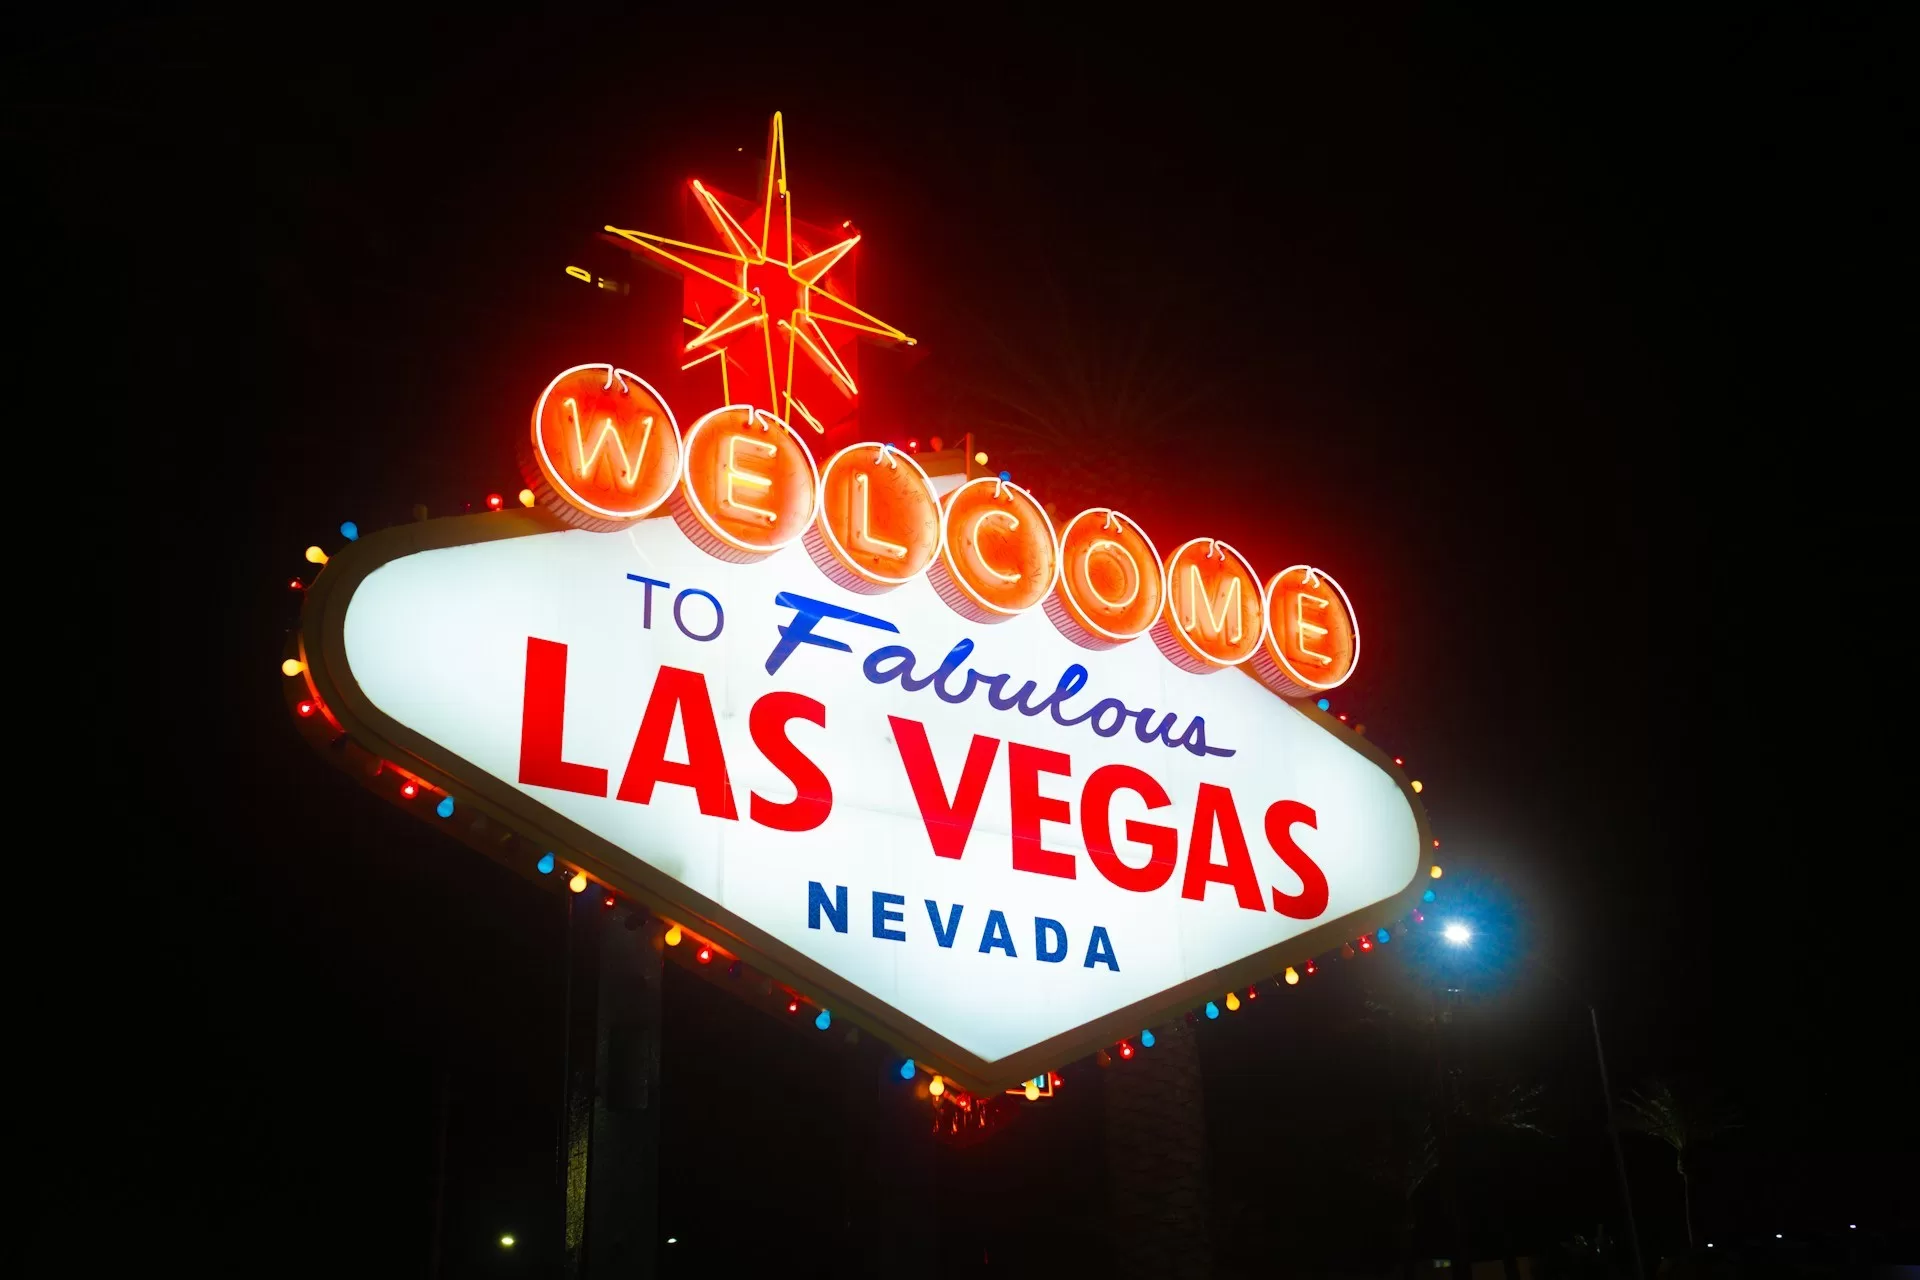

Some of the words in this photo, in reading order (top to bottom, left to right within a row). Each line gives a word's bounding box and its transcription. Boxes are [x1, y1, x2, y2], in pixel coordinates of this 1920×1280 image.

[562, 396, 1334, 666] WELCOME
[518, 636, 833, 832] LAS
[887, 714, 1330, 920] VEGAS
[626, 573, 725, 642] TO
[764, 591, 1237, 758] Fabulous
[807, 880, 1121, 972] NEVADA
